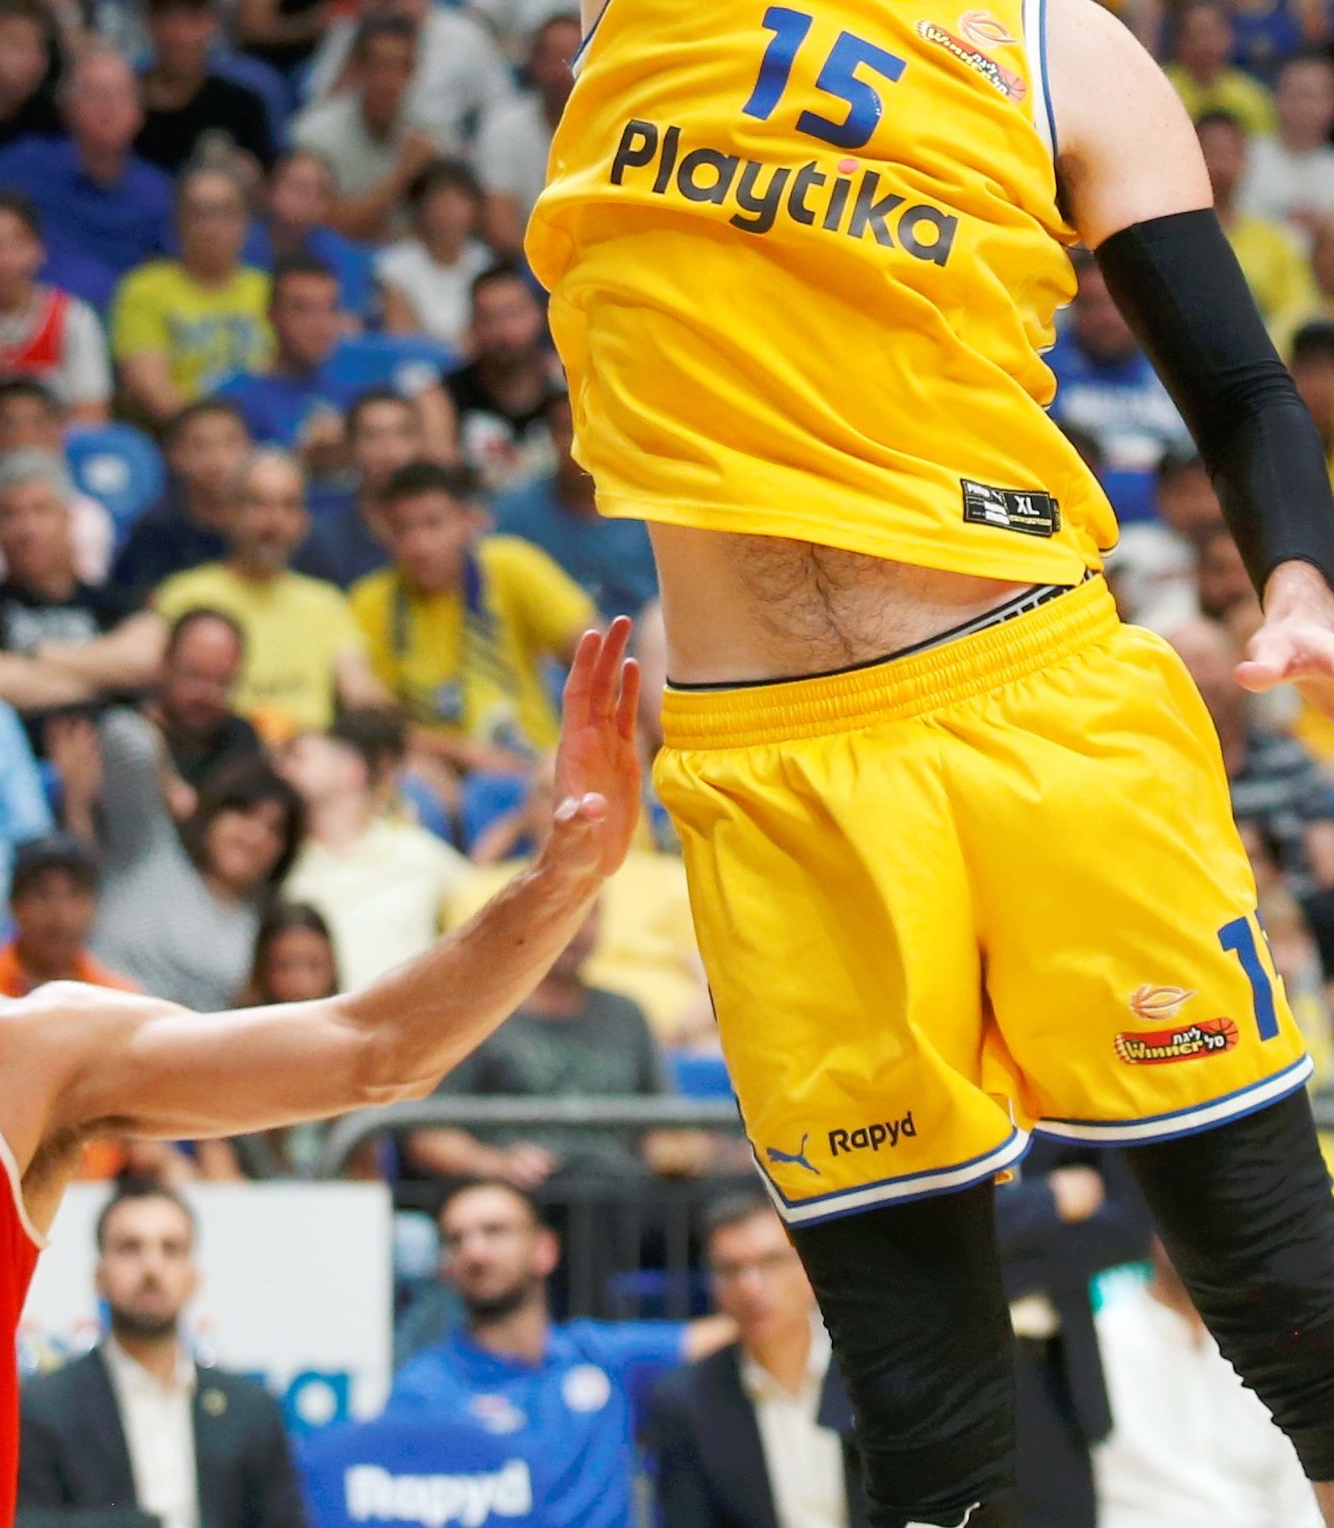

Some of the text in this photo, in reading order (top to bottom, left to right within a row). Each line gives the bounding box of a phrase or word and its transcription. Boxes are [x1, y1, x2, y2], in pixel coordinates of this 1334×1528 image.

[741, 6, 907, 149] 15
[610, 118, 960, 268] Playtika
[1013, 494, 1041, 516] XL
[1218, 909, 1281, 1043] 1
[1124, 1039, 1205, 1060] Winner
[828, 1111, 917, 1157] Rapyd
[344, 1458, 532, 1527] Rapyd
